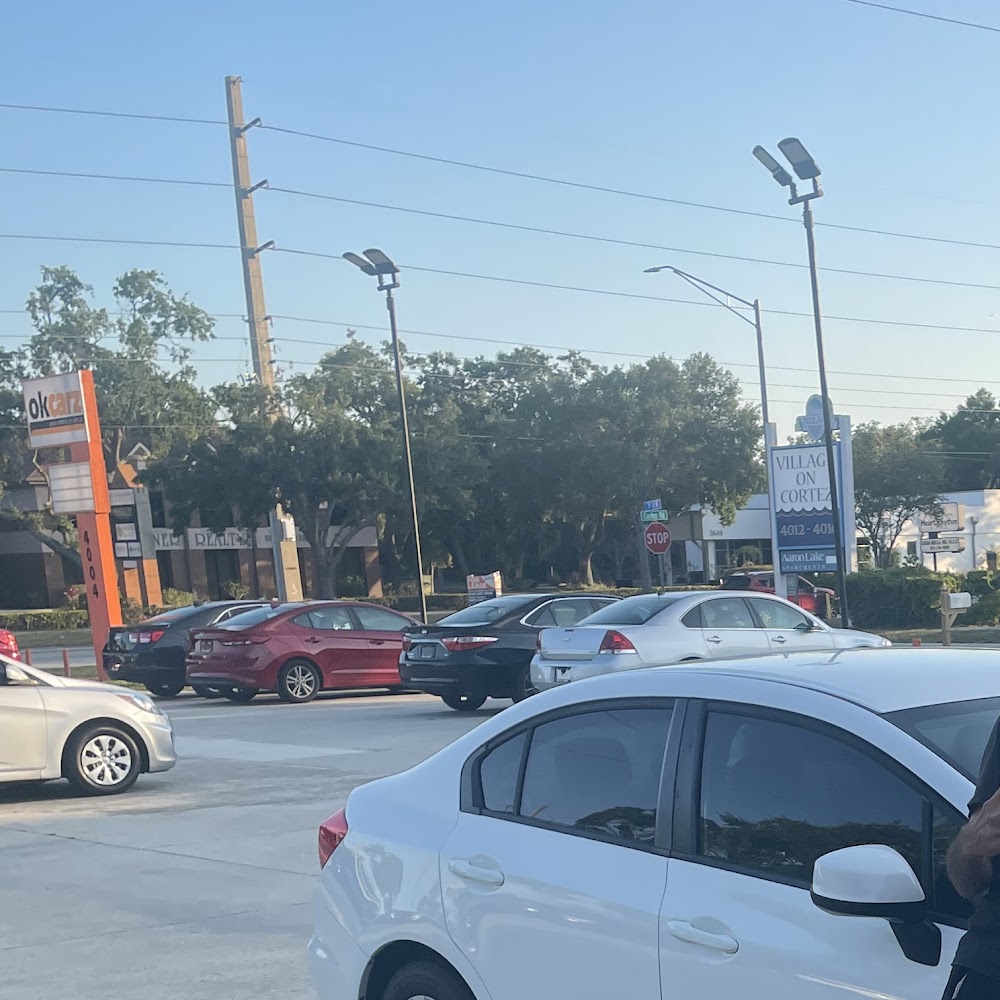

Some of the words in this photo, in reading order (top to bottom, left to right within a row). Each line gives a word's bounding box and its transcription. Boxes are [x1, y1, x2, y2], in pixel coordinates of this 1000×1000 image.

[776, 452, 826, 470] VILLAG
[795, 471, 816, 486] ON
[780, 524, 806, 537] 4012
[646, 532, 669, 545] STOP
[781, 553, 805, 562] Aaron
[805, 551, 826, 562] Lake
[83, 530, 99, 599] 4004
